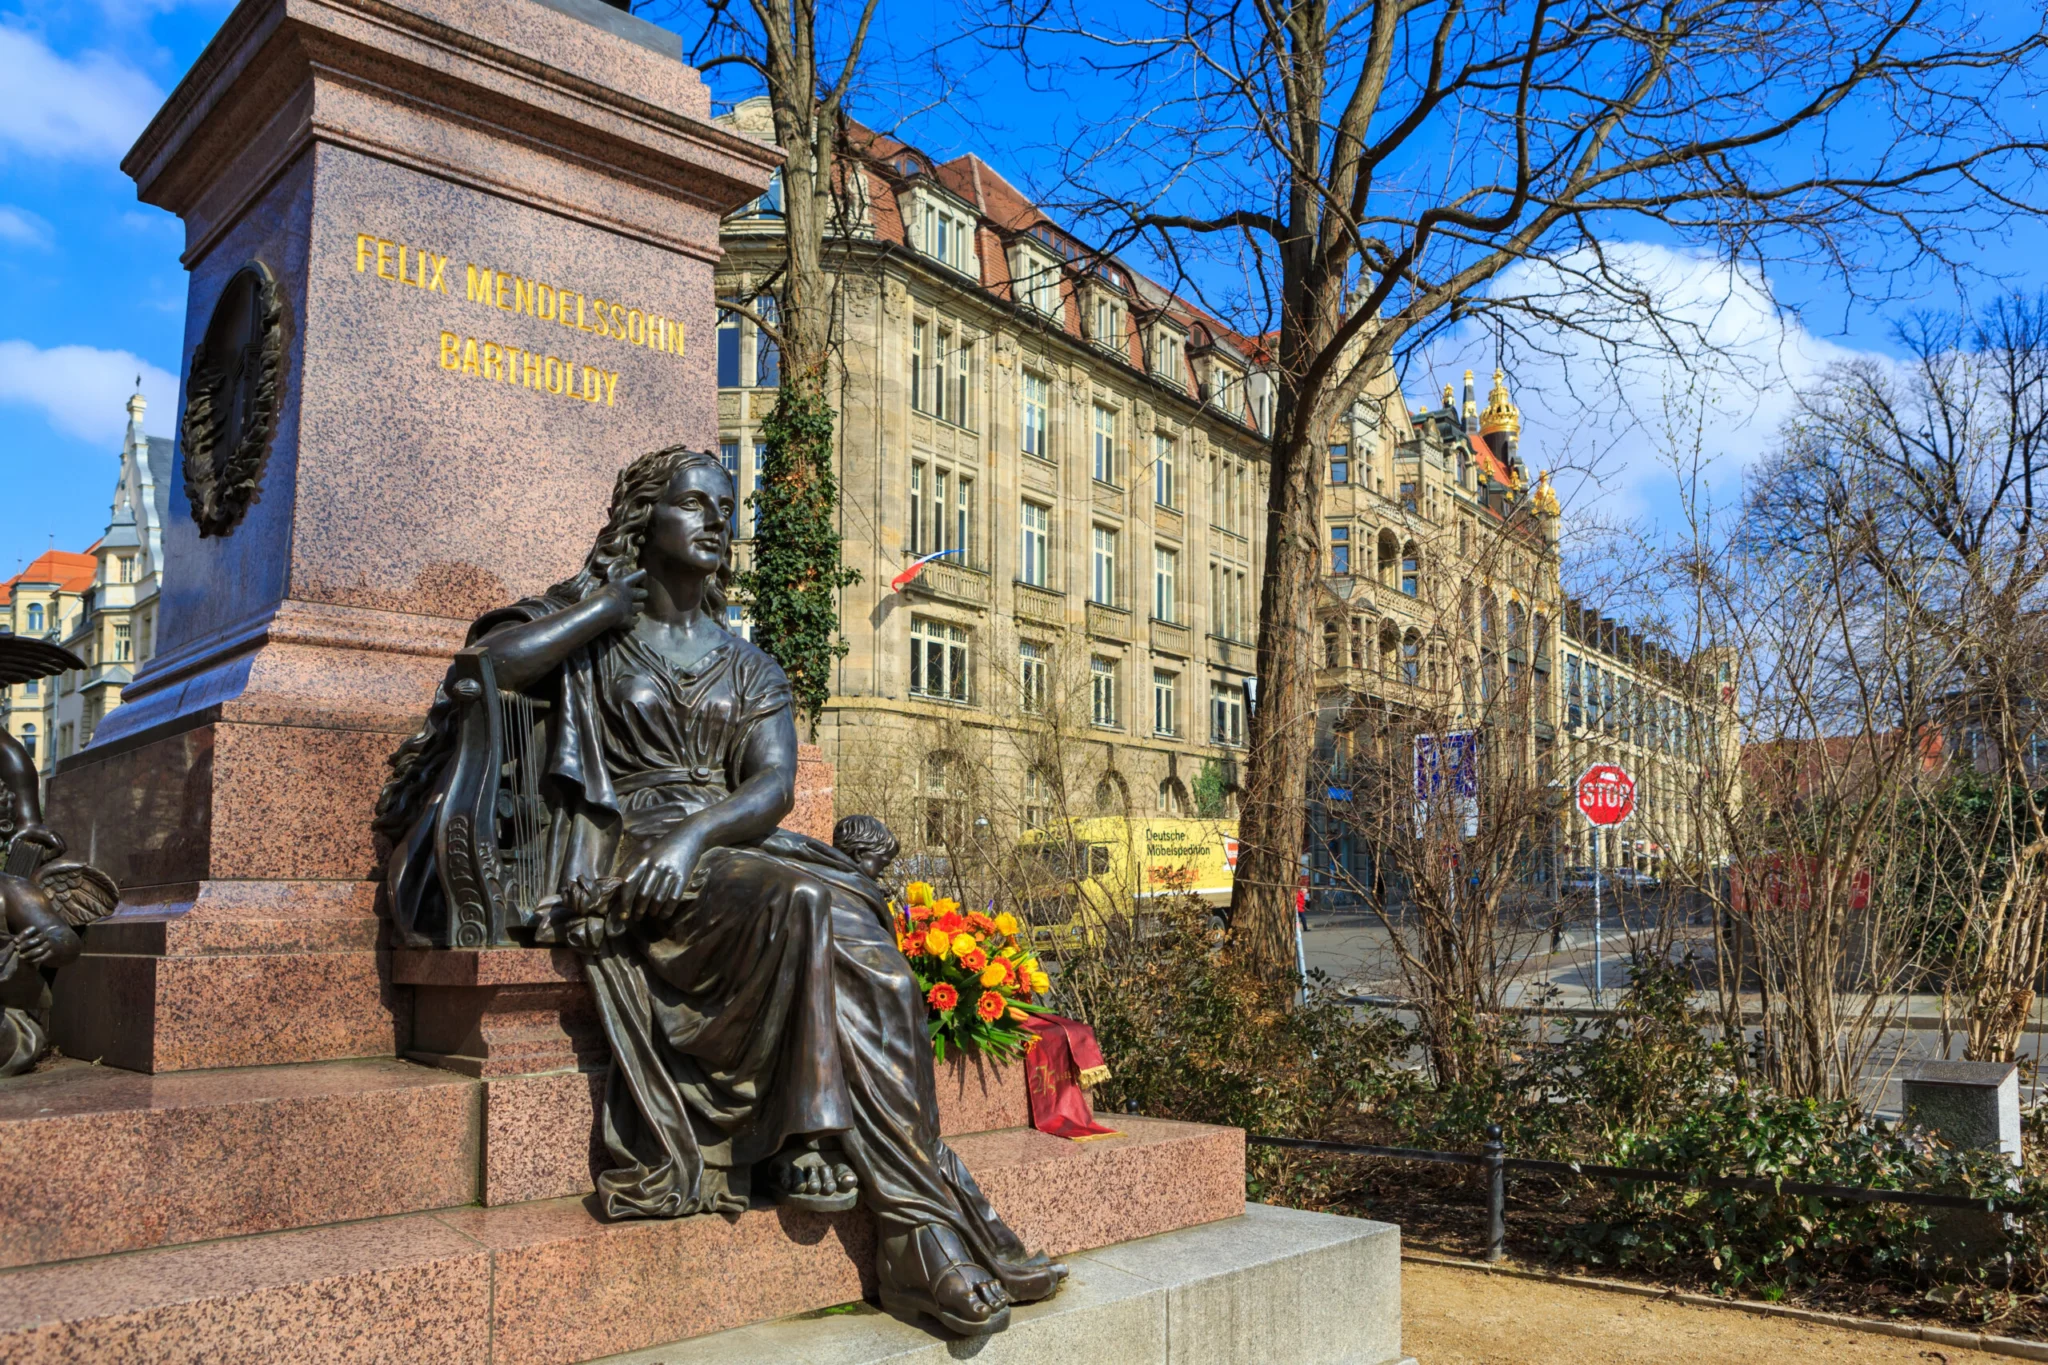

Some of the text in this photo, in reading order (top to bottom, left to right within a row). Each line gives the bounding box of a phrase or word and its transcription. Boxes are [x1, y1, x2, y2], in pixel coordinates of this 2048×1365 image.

[357, 232, 685, 357] FELIX MENDELSSOHN
[440, 330, 619, 407] BARTHOLDY
[1583, 782, 1630, 808] STOP
[1146, 828, 1185, 841] Deutsche
[1147, 844, 1210, 858] Möbelspedition
